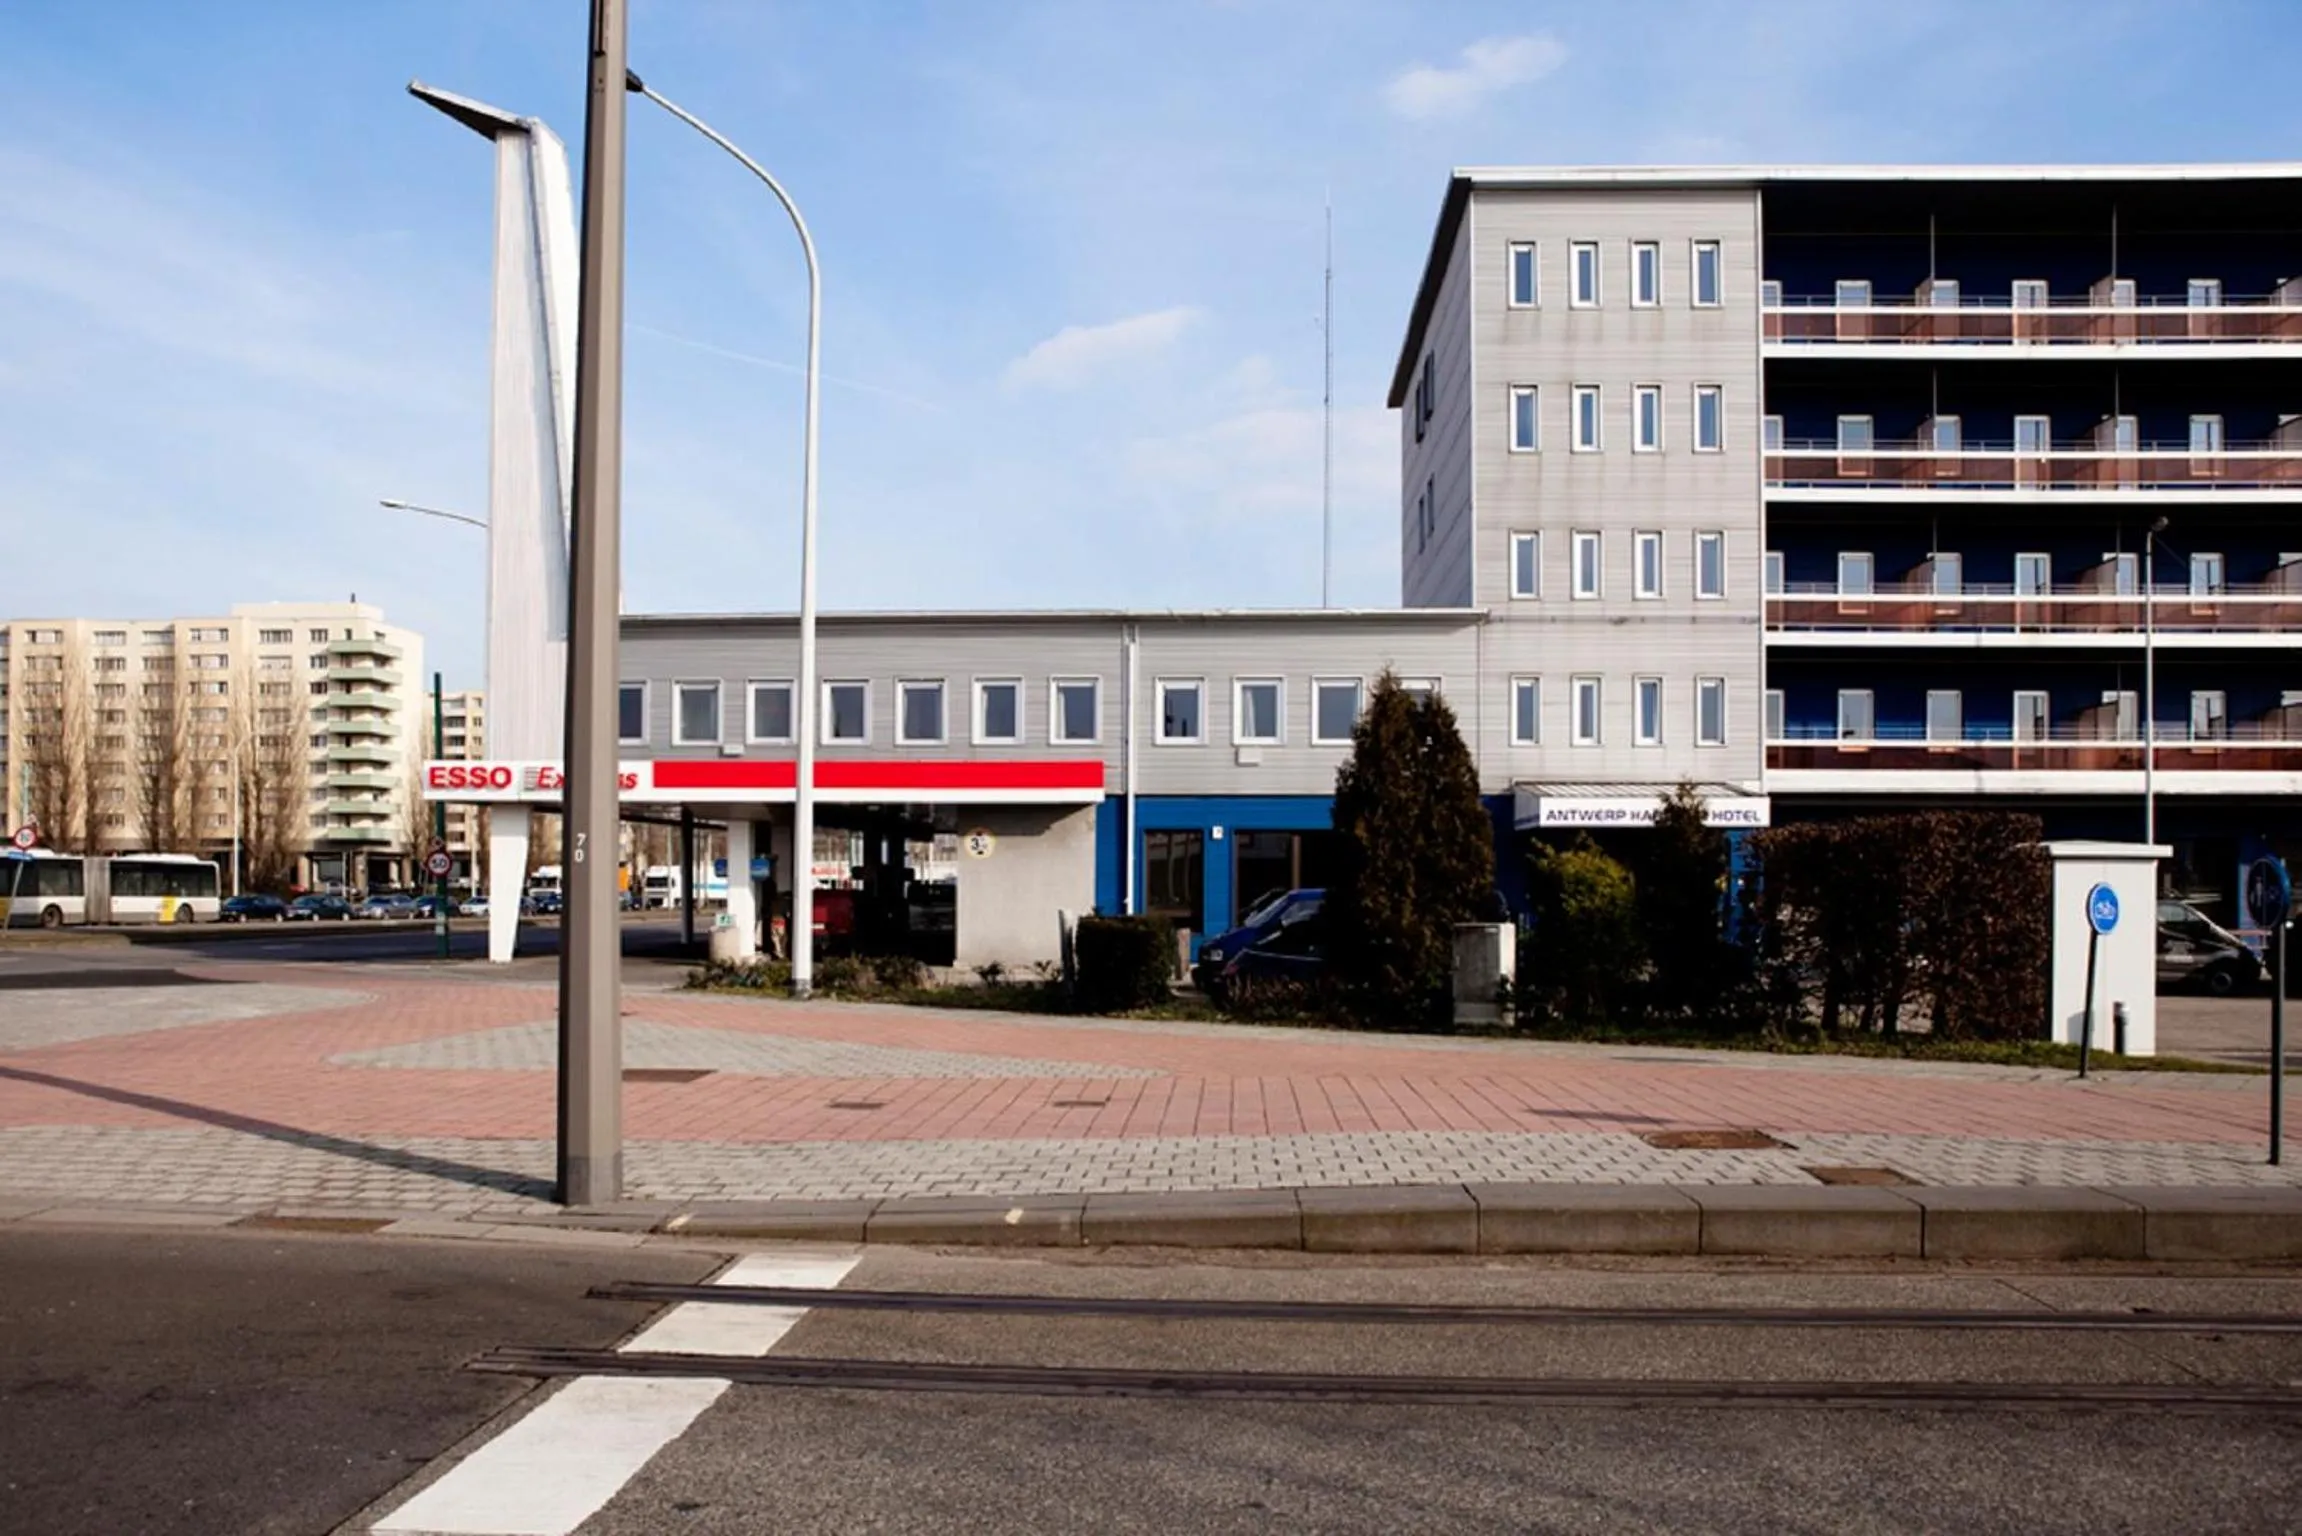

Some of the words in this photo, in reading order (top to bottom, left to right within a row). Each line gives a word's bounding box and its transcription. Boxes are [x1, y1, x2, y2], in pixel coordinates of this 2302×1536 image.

[429, 766, 512, 789] ESSO
[1546, 809, 1627, 821] ANTWERP
[1711, 809, 1761, 821] HOTEL
